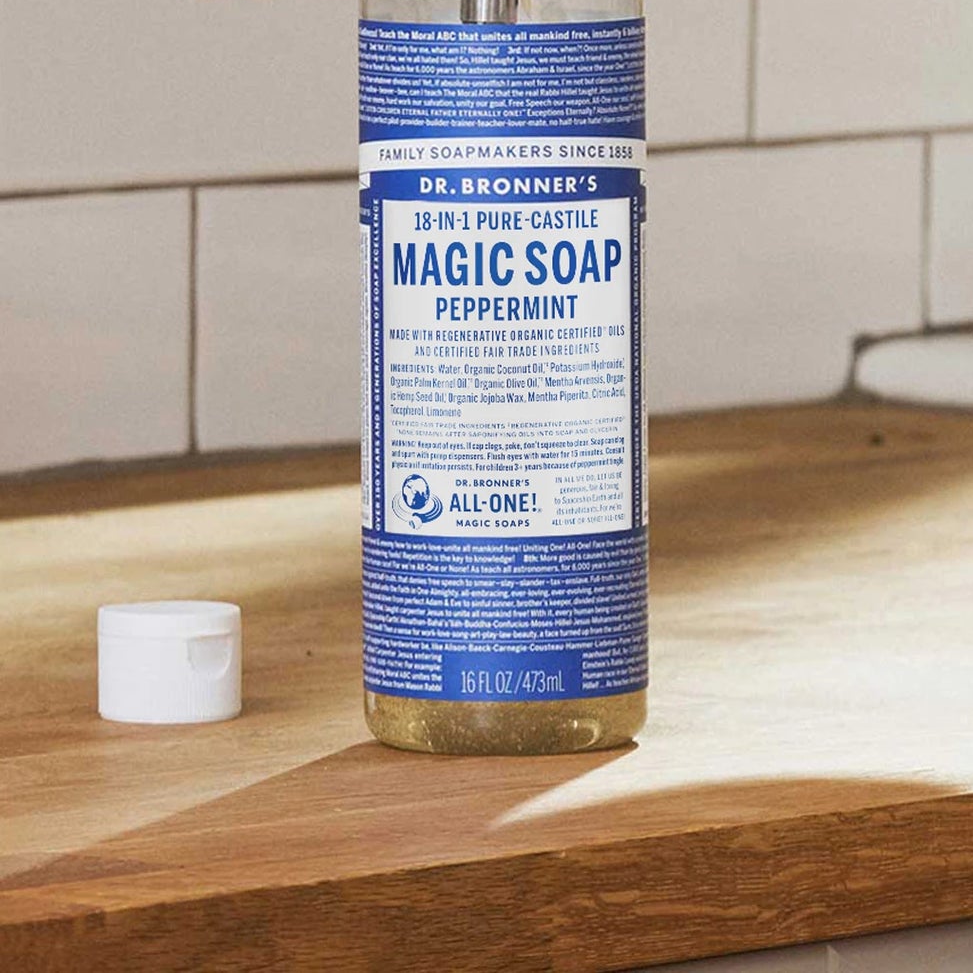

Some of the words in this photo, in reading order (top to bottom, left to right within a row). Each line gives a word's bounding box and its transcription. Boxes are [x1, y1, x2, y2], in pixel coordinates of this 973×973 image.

[397, 31, 409, 40] the
[411, 30, 435, 41] Moral
[437, 31, 457, 41] ABC
[458, 31, 479, 41] that
[481, 31, 512, 41] unites
[514, 31, 527, 41] all
[529, 30, 569, 40] mankind
[379, 147, 425, 161] FAMILY
[430, 144, 553, 159] SOAPMAKERS
[559, 144, 606, 159] SINCE
[608, 145, 633, 159] 1858
[420, 176, 457, 195] DR.
[461, 175, 598, 196] BRONNER'S
[414, 211, 470, 231] 18-IN-1
[477, 209, 599, 230] PURE-CASTILE
[393, 241, 515, 286] MAGIC
[525, 239, 622, 285] SOAP
[436, 294, 579, 321] PEPPERMINT
[389, 328, 410, 341] MADE
[412, 329, 433, 341] WITH
[435, 330, 507, 342] REGENERATIVE
[510, 329, 555, 341] ORGANIC
[608, 324, 625, 337] OILS
[414, 345, 431, 357] AND
[433, 346, 480, 358] CERTIFIED
[483, 346, 505, 358] FAIR
[507, 345, 538, 358] TRADE
[540, 342, 600, 357] INGREDIENTS
[464, 364, 496, 376] Organic
[497, 363, 531, 375] Coconut
[474, 378, 505, 391] Organic
[506, 377, 526, 389] Olive
[448, 392, 479, 405] Organic
[527, 391, 558, 403] Mentha
[455, 478, 472, 488] DR.
[473, 478, 531, 488] BRONNER'S
[456, 519, 491, 528] MAGIC
[494, 519, 531, 528] SOAPS
[461, 670, 476, 694] 16
[479, 670, 493, 694] FL
